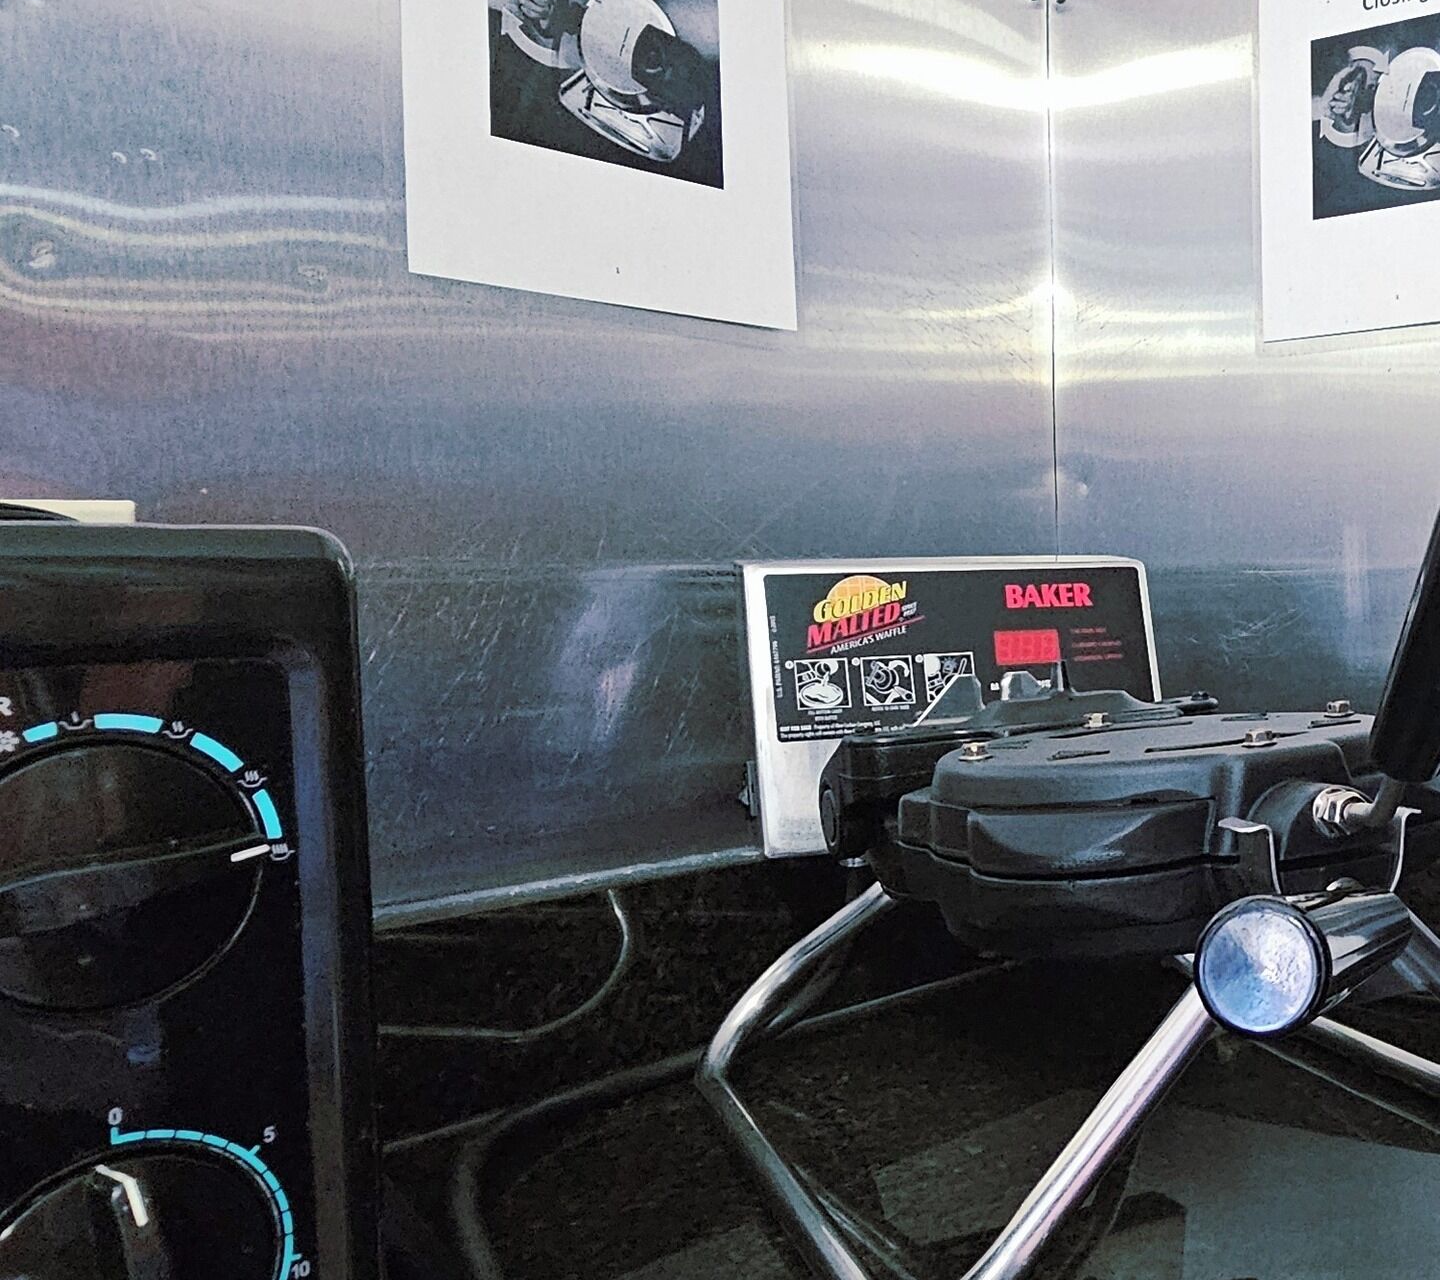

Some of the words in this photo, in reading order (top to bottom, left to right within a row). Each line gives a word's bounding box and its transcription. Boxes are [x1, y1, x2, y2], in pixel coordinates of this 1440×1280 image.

[813, 581, 907, 623] GOLDEN
[1004, 583, 1094, 609] BAKER
[807, 602, 901, 648] MALTED
[875, 625, 907, 641] WAFFLE
[107, 1108, 123, 1125] 0
[262, 1126, 276, 1143] 5
[291, 1260, 311, 1279] 10
